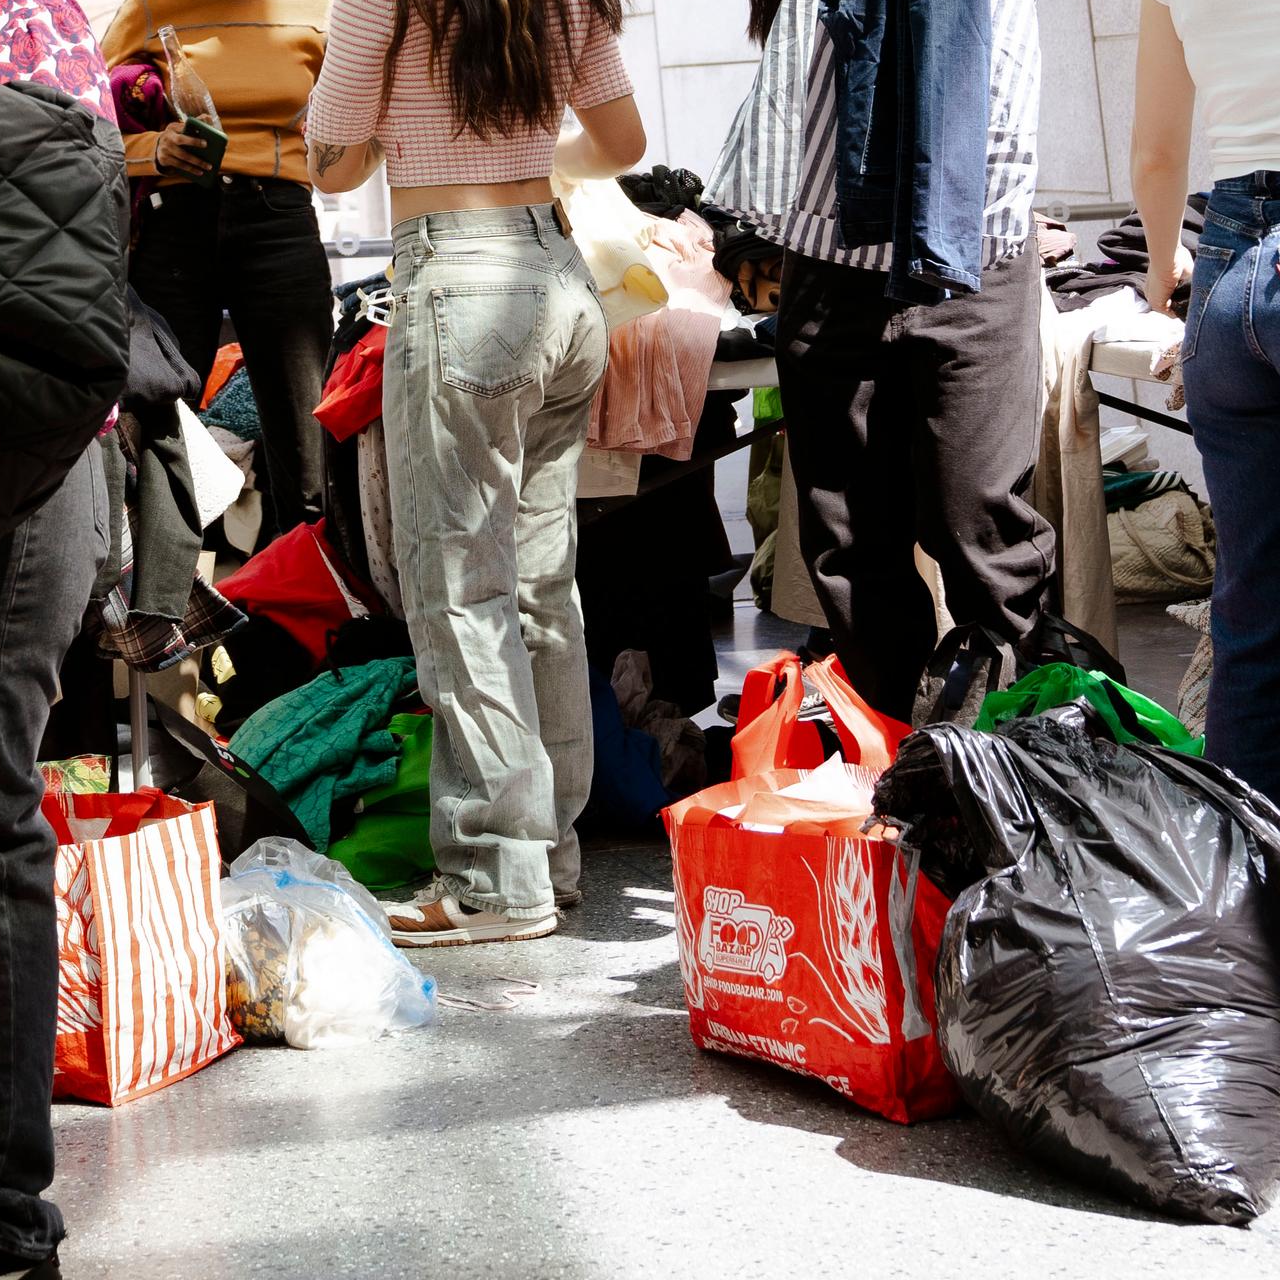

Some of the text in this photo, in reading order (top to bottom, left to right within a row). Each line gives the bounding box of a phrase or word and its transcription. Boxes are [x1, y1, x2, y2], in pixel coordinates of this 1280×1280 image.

[706, 888, 741, 915] SHOP
[710, 920, 761, 950] FOOD
[715, 941, 753, 957] BAZAAR
[703, 975, 784, 1003] SHOP.FOODBAZAAR.COM
[748, 1034, 807, 1065] ETHNIC
